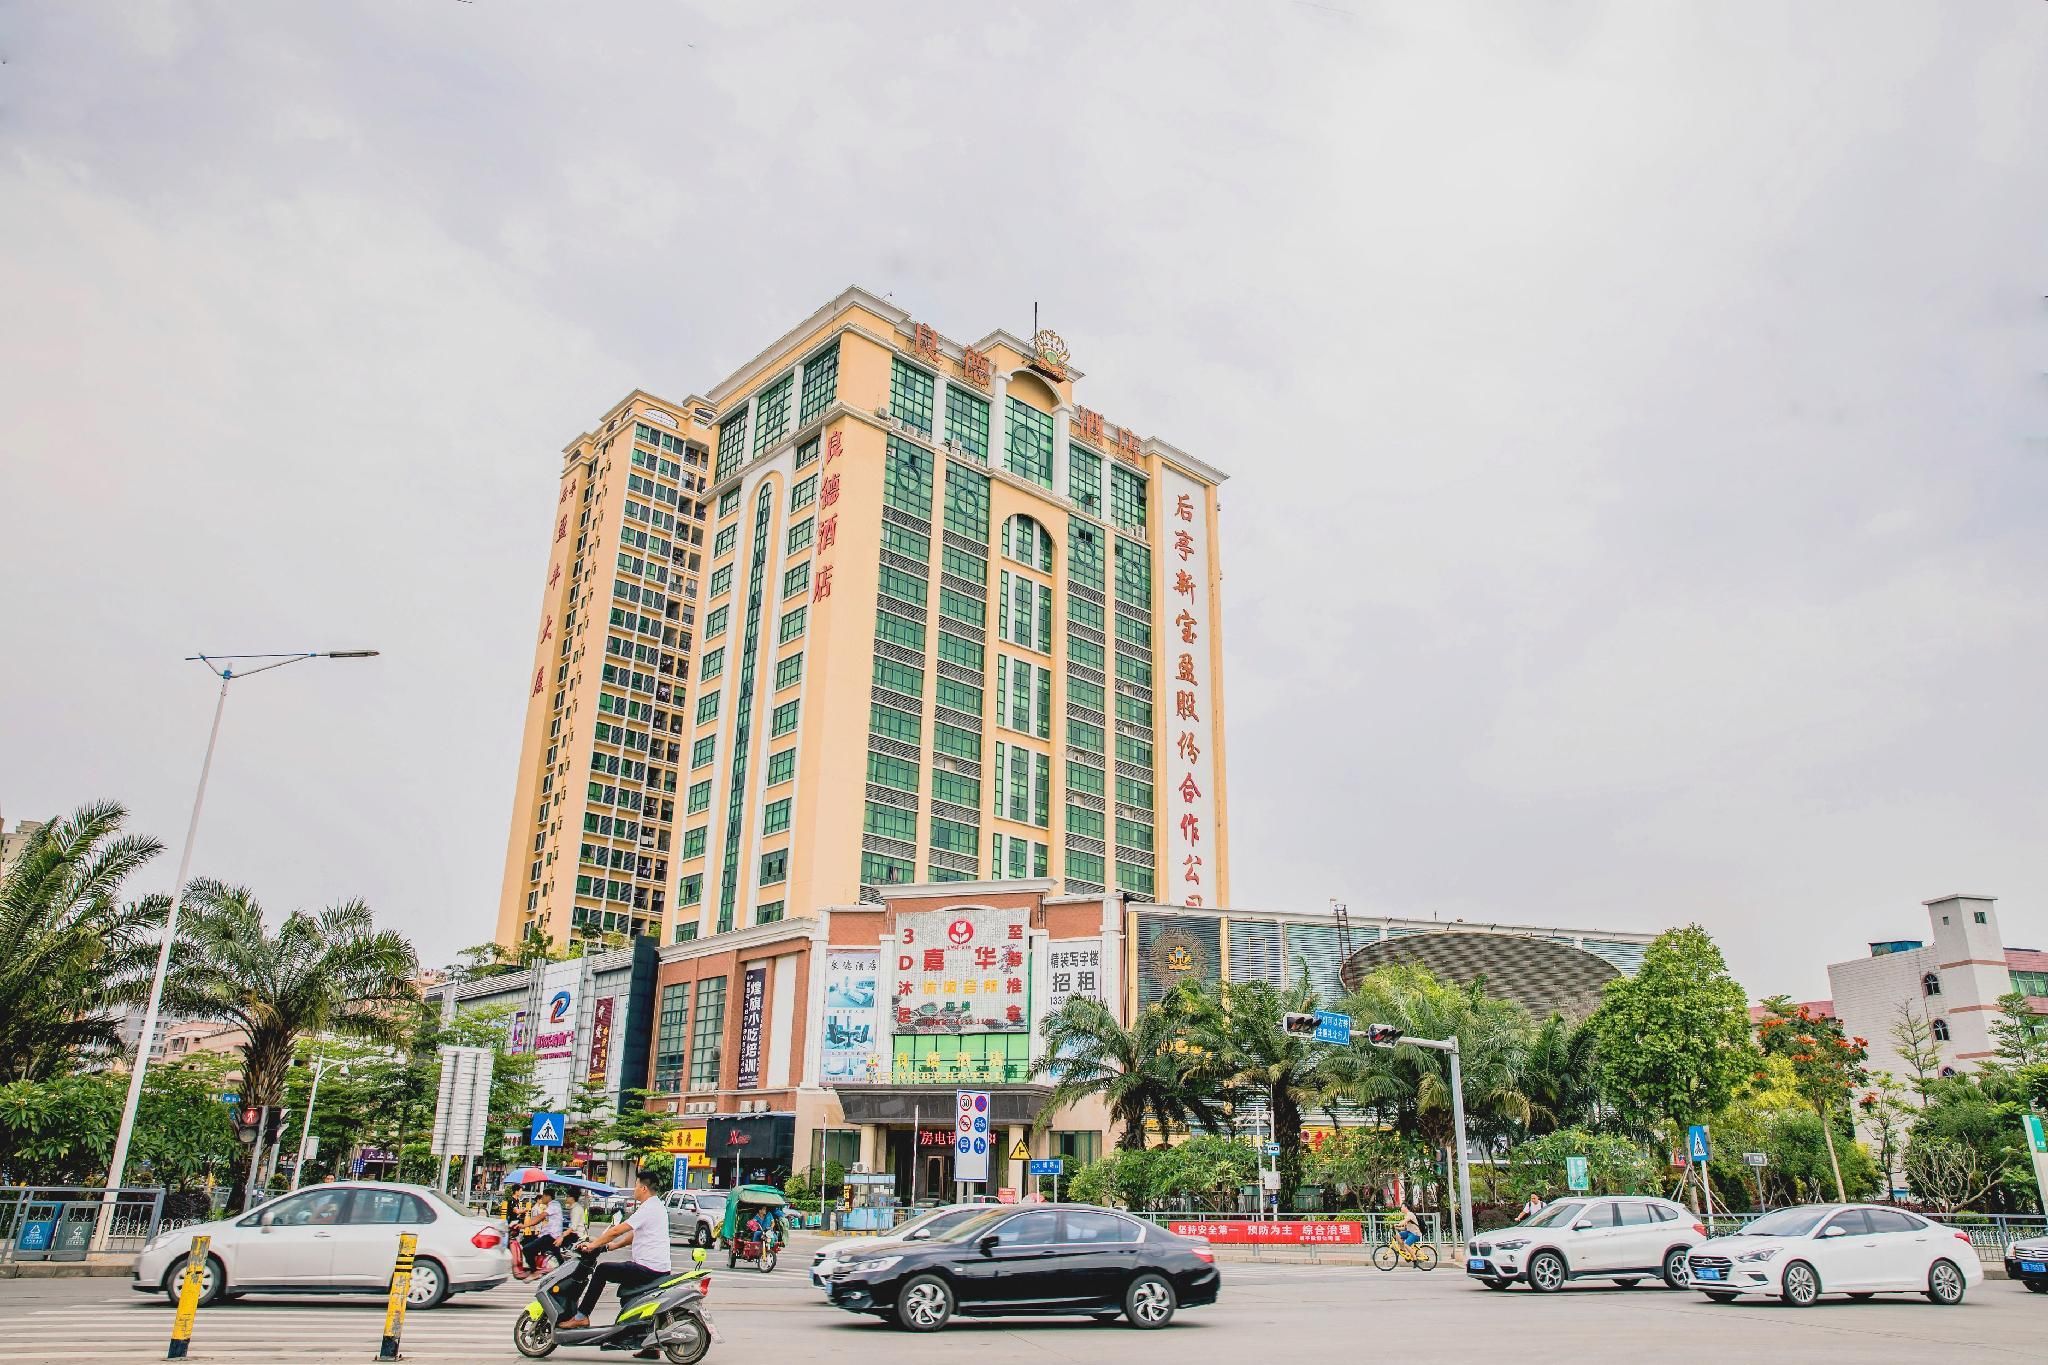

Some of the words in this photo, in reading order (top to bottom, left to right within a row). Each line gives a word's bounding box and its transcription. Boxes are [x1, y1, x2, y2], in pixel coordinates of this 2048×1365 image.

[813, 431, 843, 604] 良德酒店
[923, 945, 997, 971] 嘉华
[1050, 950, 1099, 968] 精装写字楼
[1052, 971, 1096, 992] 招租
[1178, 1224, 1239, 1235] 坚持安全第一
[1247, 1224, 1293, 1236] 预防为主
[1302, 1224, 1351, 1235] 综合治理
